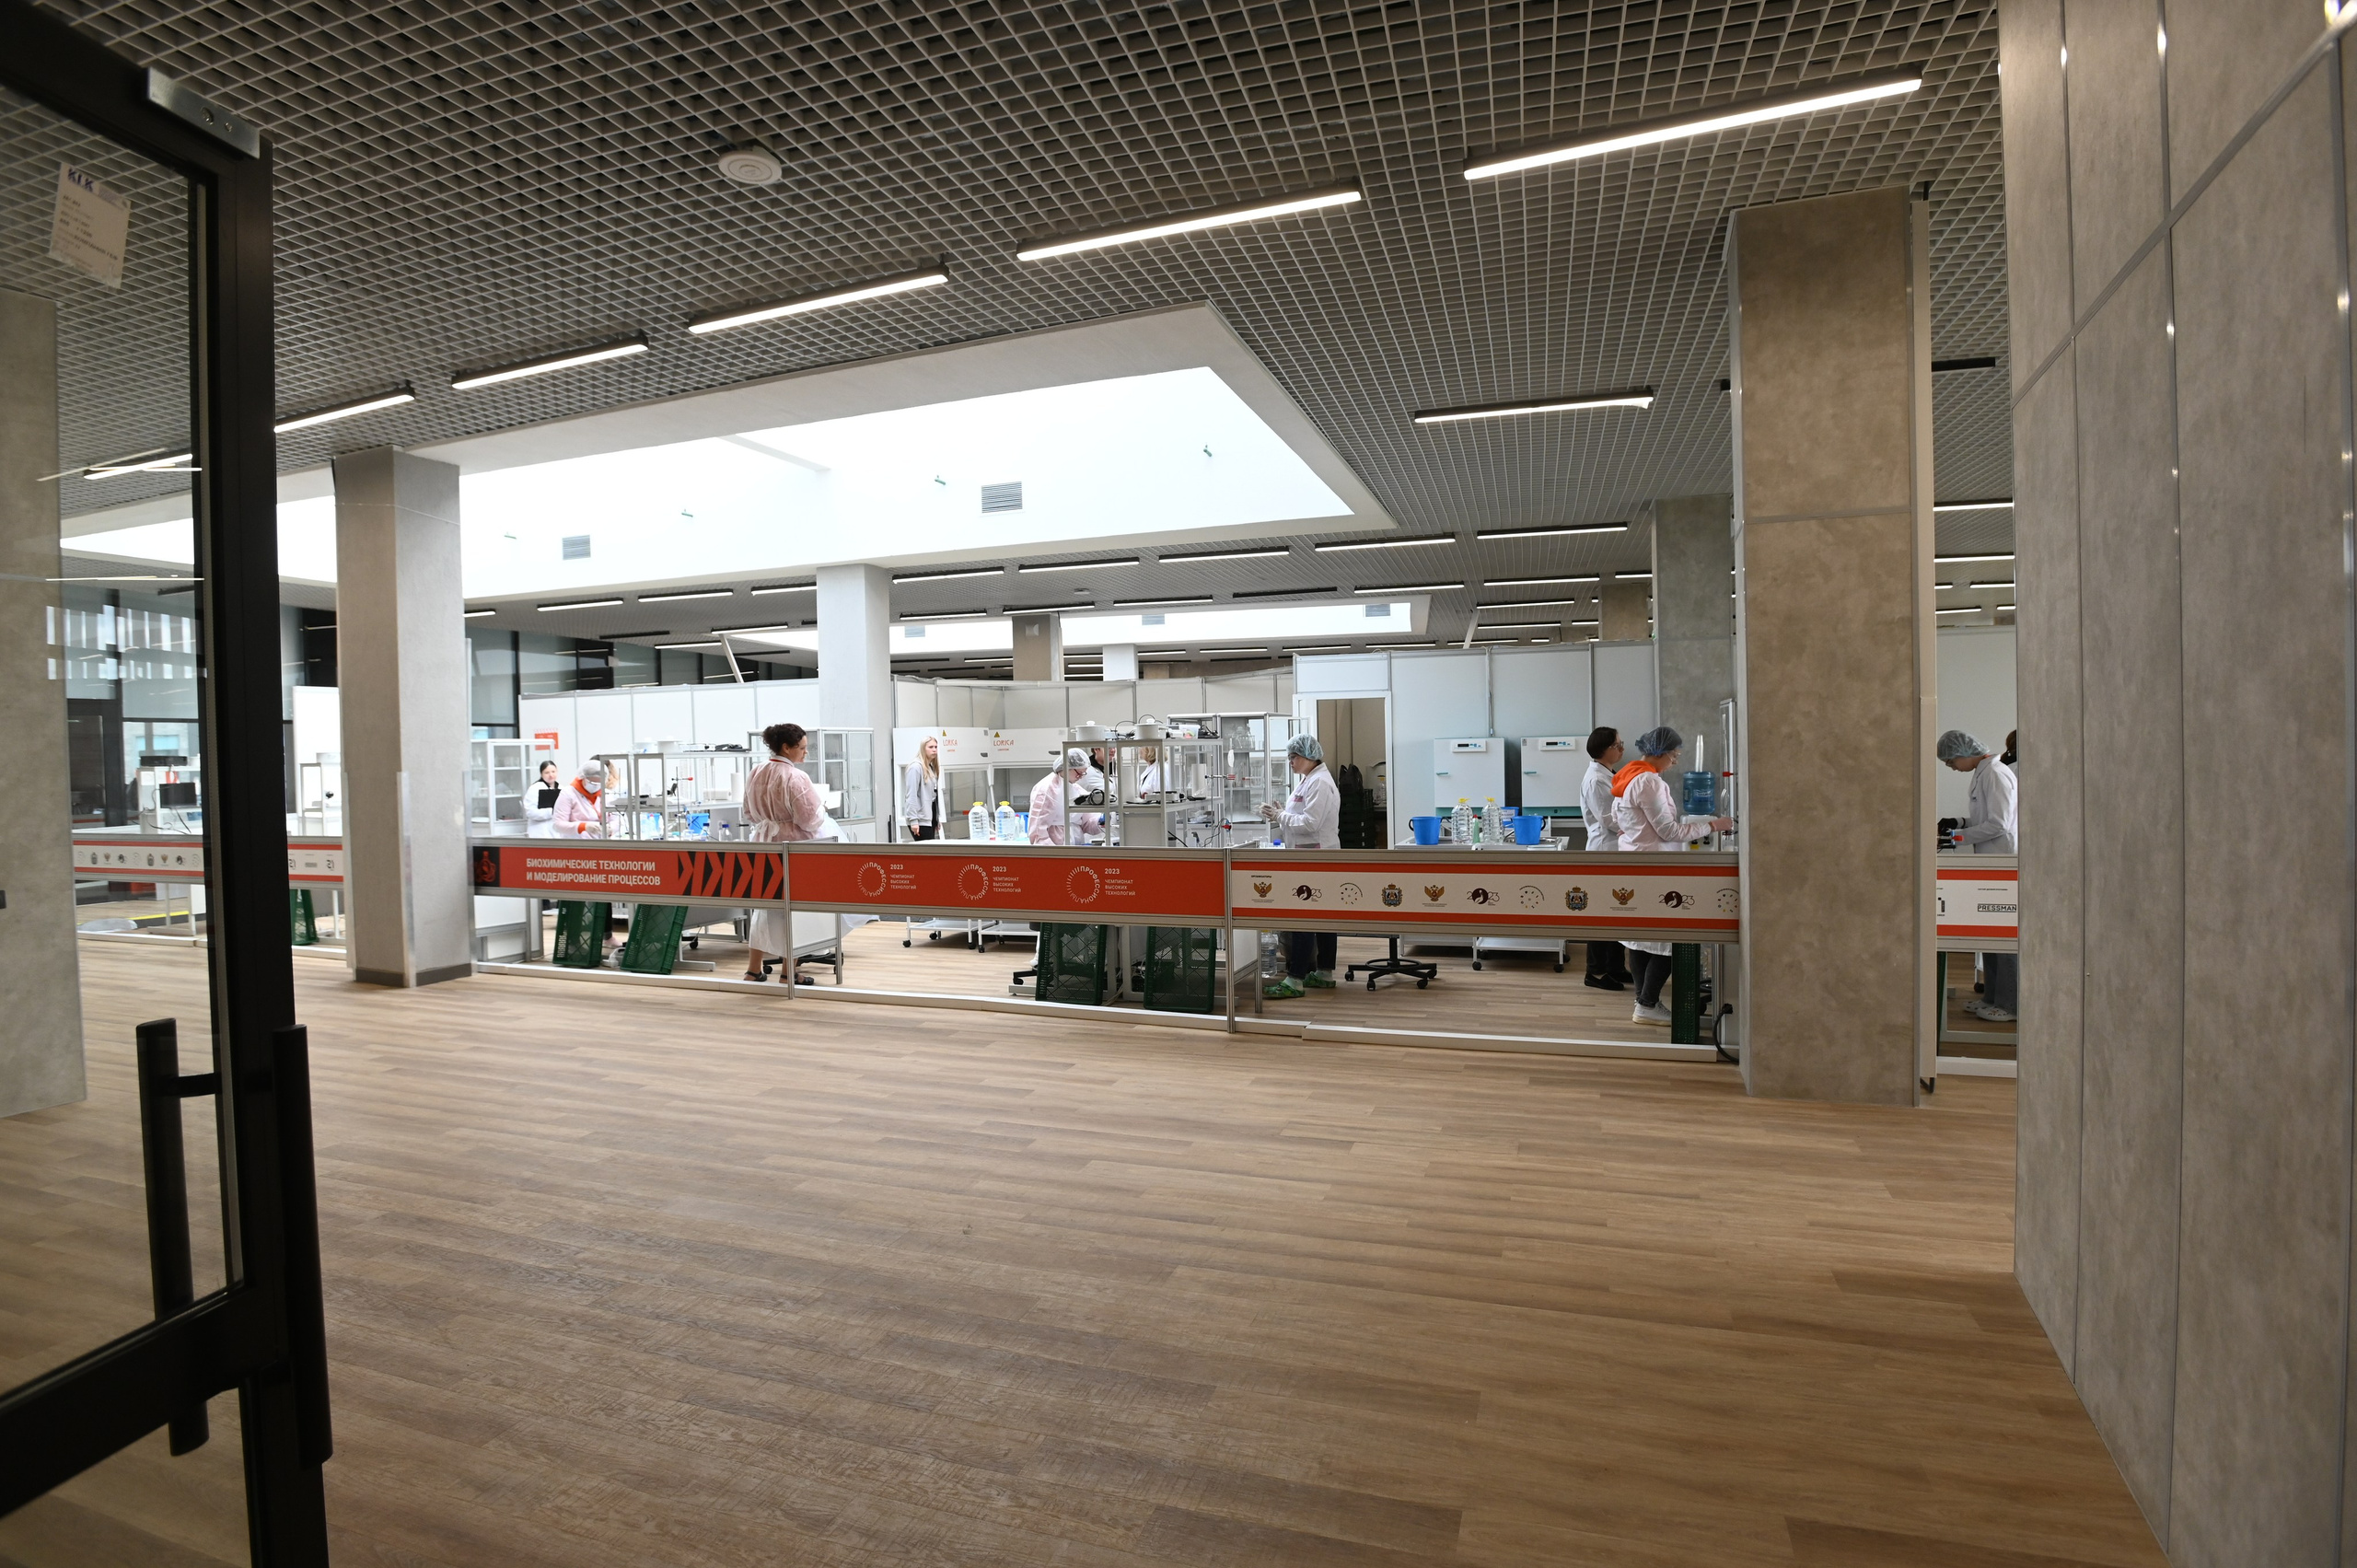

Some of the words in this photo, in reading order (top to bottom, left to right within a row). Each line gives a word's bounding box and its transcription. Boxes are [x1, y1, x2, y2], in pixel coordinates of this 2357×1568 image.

[527, 858, 598, 869] БИОХИМИЧЕСКИЕ
[598, 860, 656, 871] ТЕХНОЛОГИИ
[527, 871, 533, 881] И
[534, 871, 607, 884] МОДЕЛИРОВАНИЕ
[608, 874, 661, 887] ПРОЦЕССОВ
